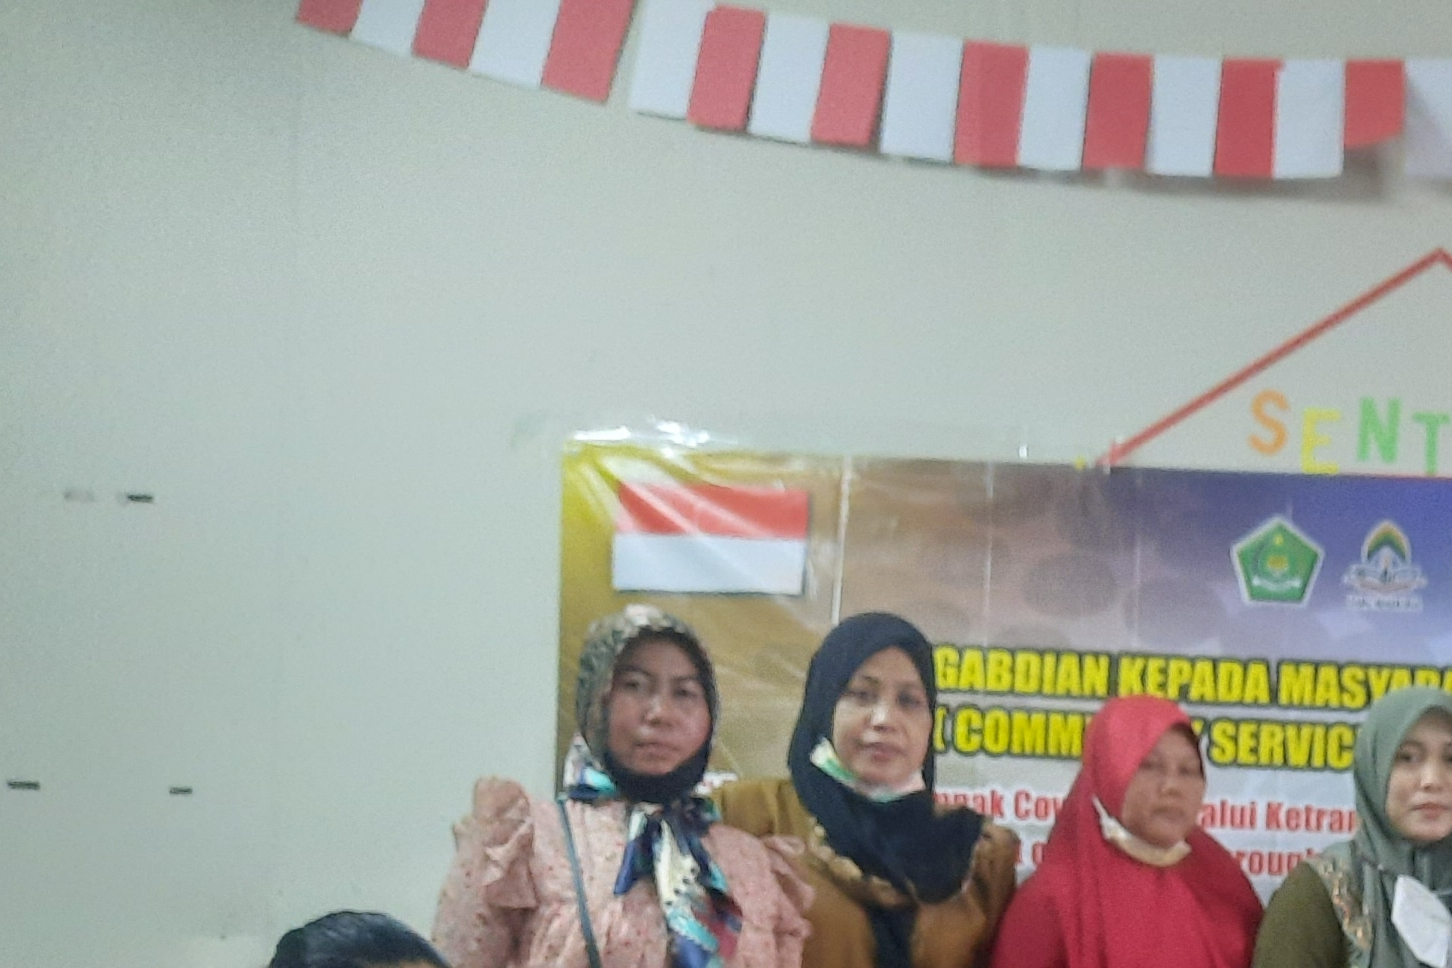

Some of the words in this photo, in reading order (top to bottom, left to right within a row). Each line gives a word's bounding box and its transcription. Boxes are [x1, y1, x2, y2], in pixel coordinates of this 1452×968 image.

[934, 645, 1109, 696] GABDIAN
[1118, 656, 1270, 705] KEPADA
[1210, 720, 1355, 769] SERVIC
